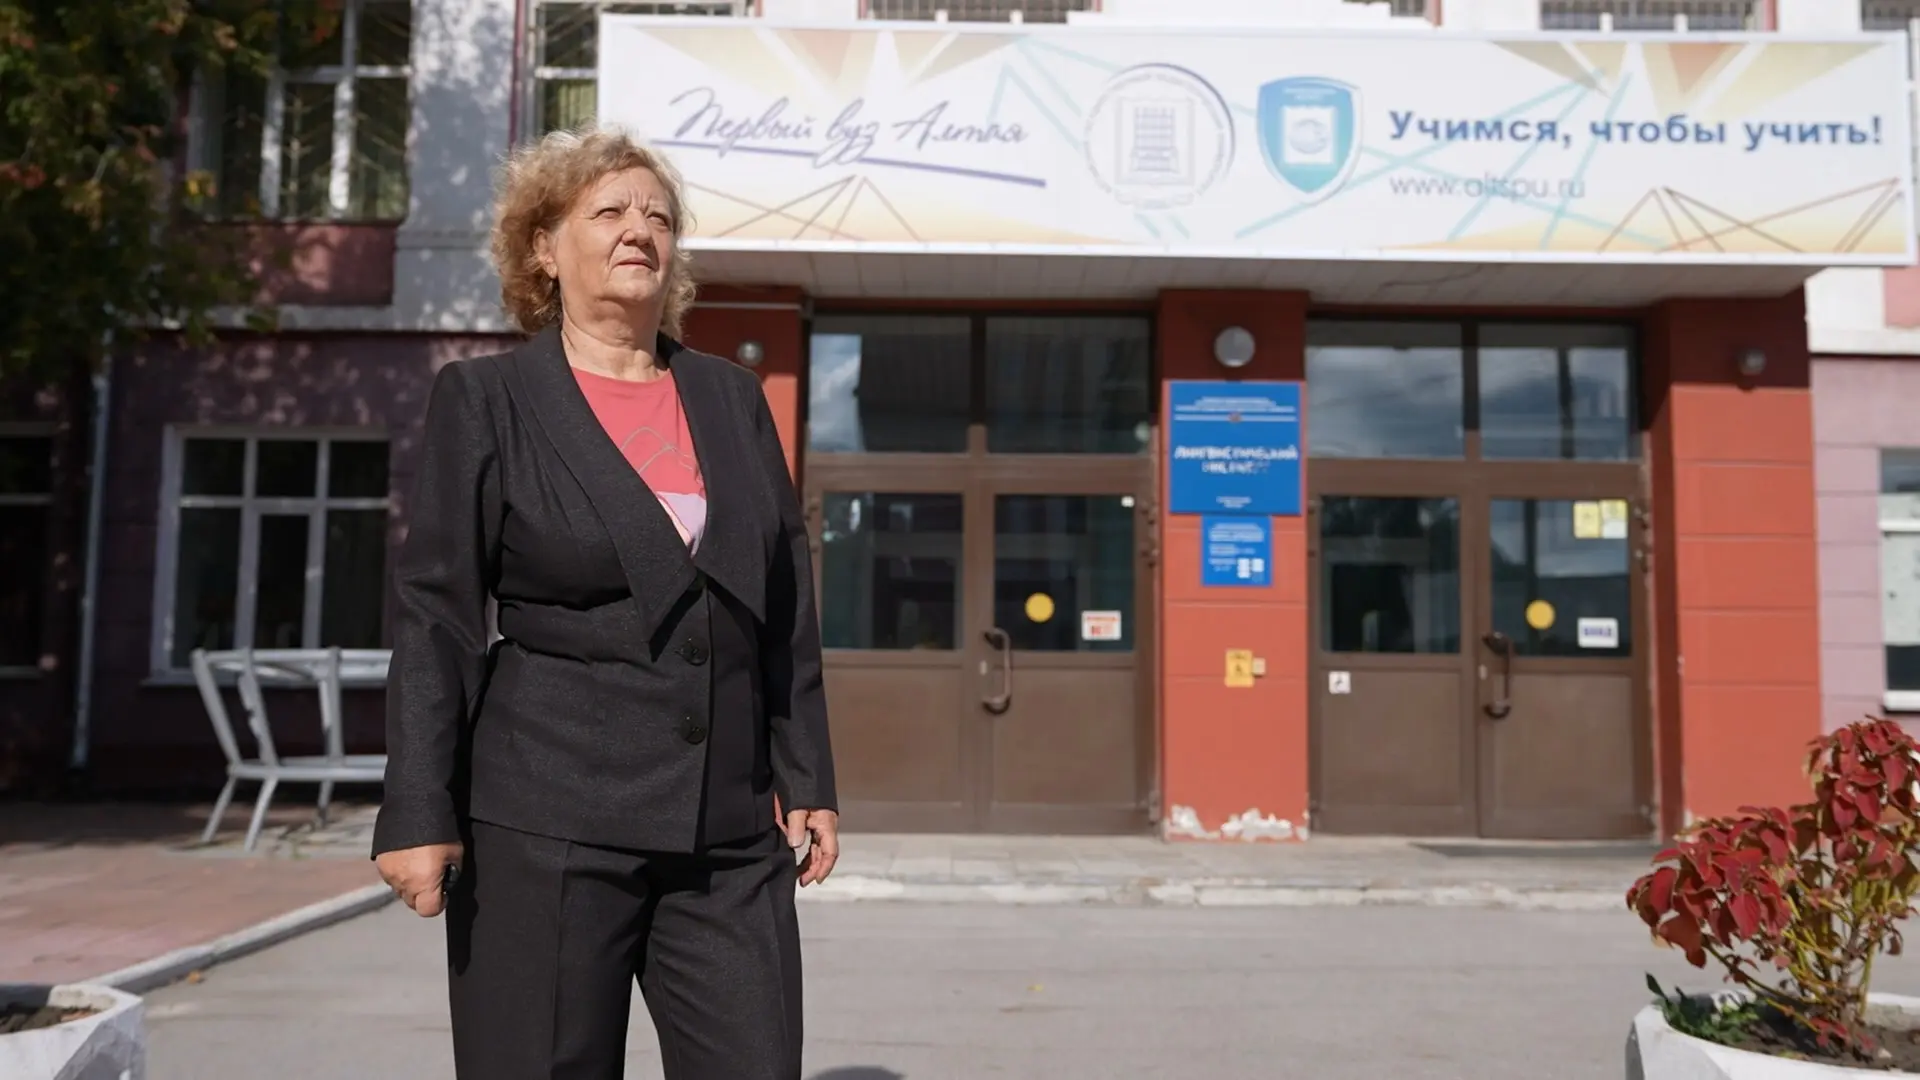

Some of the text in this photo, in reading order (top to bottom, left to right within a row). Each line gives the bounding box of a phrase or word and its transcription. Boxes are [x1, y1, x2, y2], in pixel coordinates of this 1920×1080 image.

[668, 86, 816, 159] Первый
[812, 96, 880, 169] вуз
[892, 100, 1028, 150] Алтая
[1389, 110, 1883, 152] Учимся, чтобы учить!
[1389, 172, 1587, 203] www.altspu.ru
